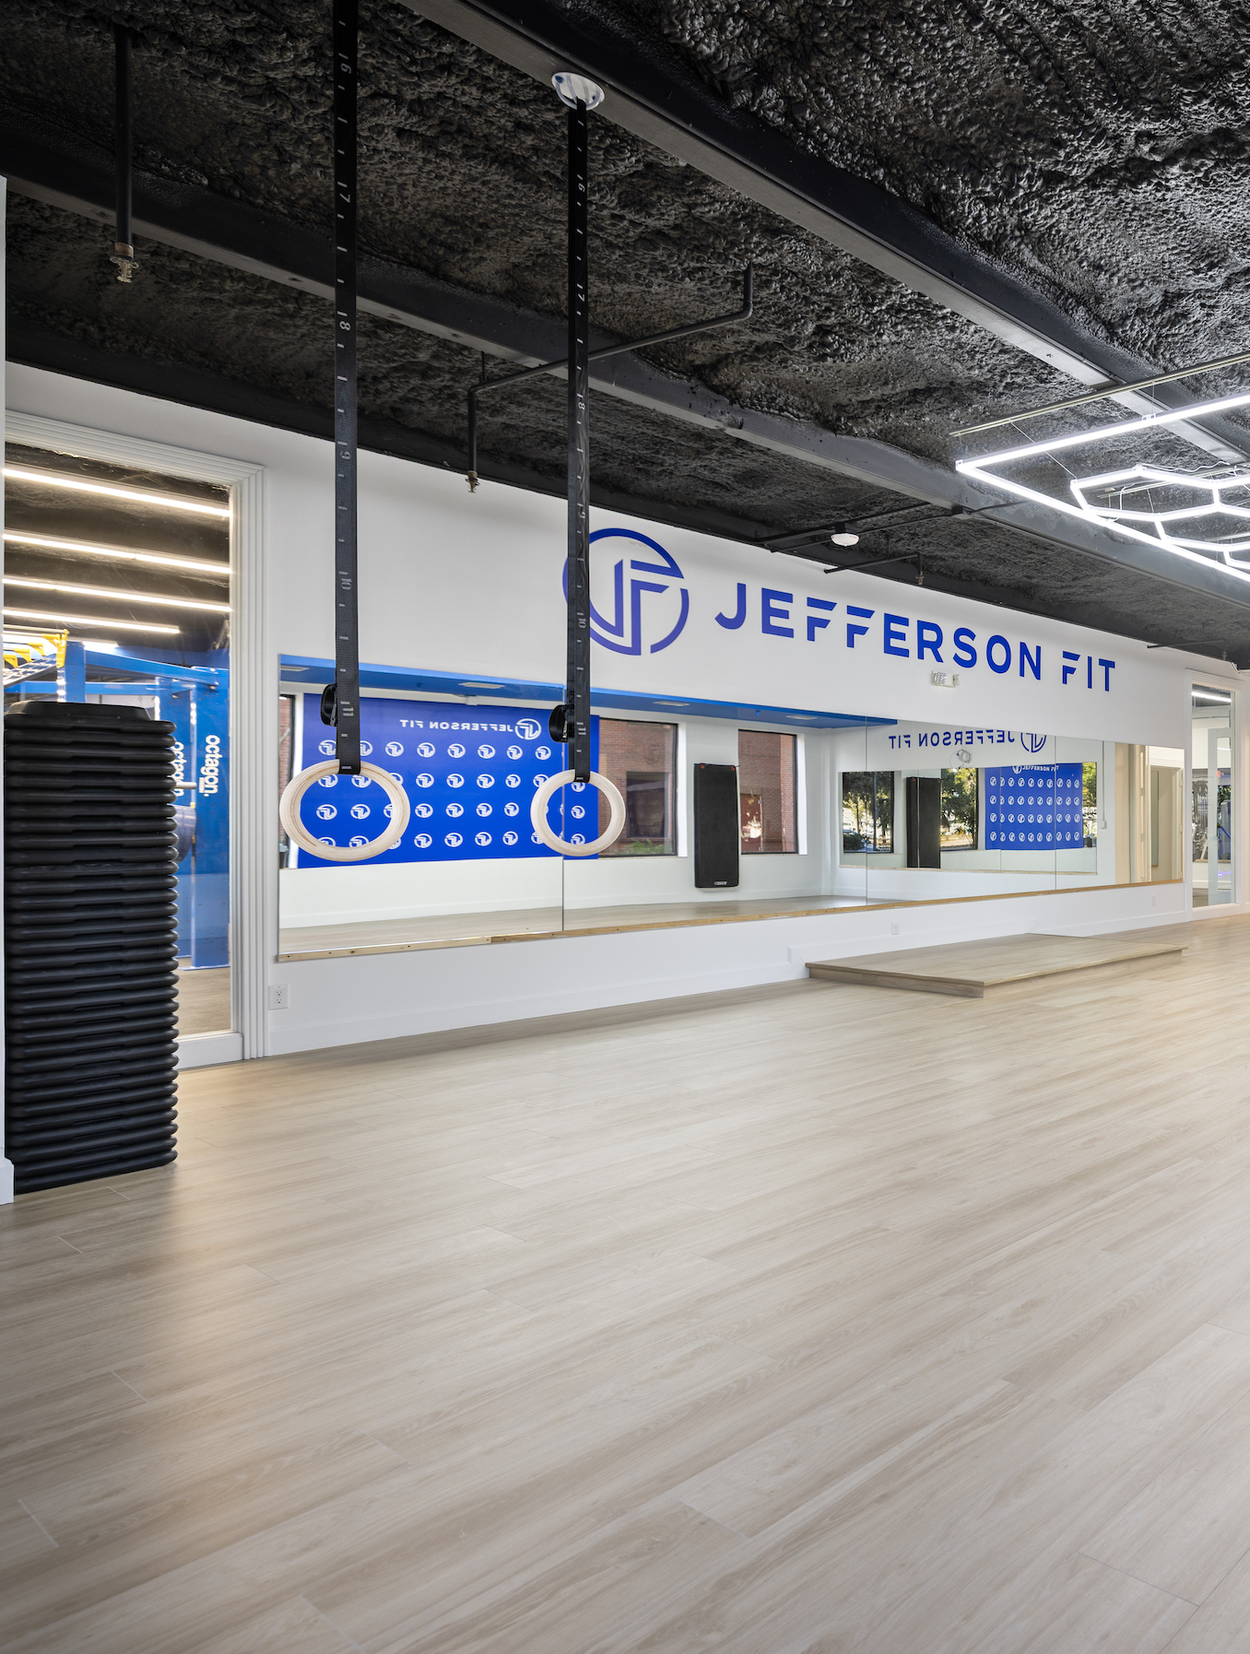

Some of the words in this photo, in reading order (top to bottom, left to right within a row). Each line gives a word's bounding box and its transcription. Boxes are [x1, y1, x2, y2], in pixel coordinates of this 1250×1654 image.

[339, 320, 351, 331] 8
[714, 582, 1042, 681] JEFFERSON
[1061, 650, 1117, 693] FIT
